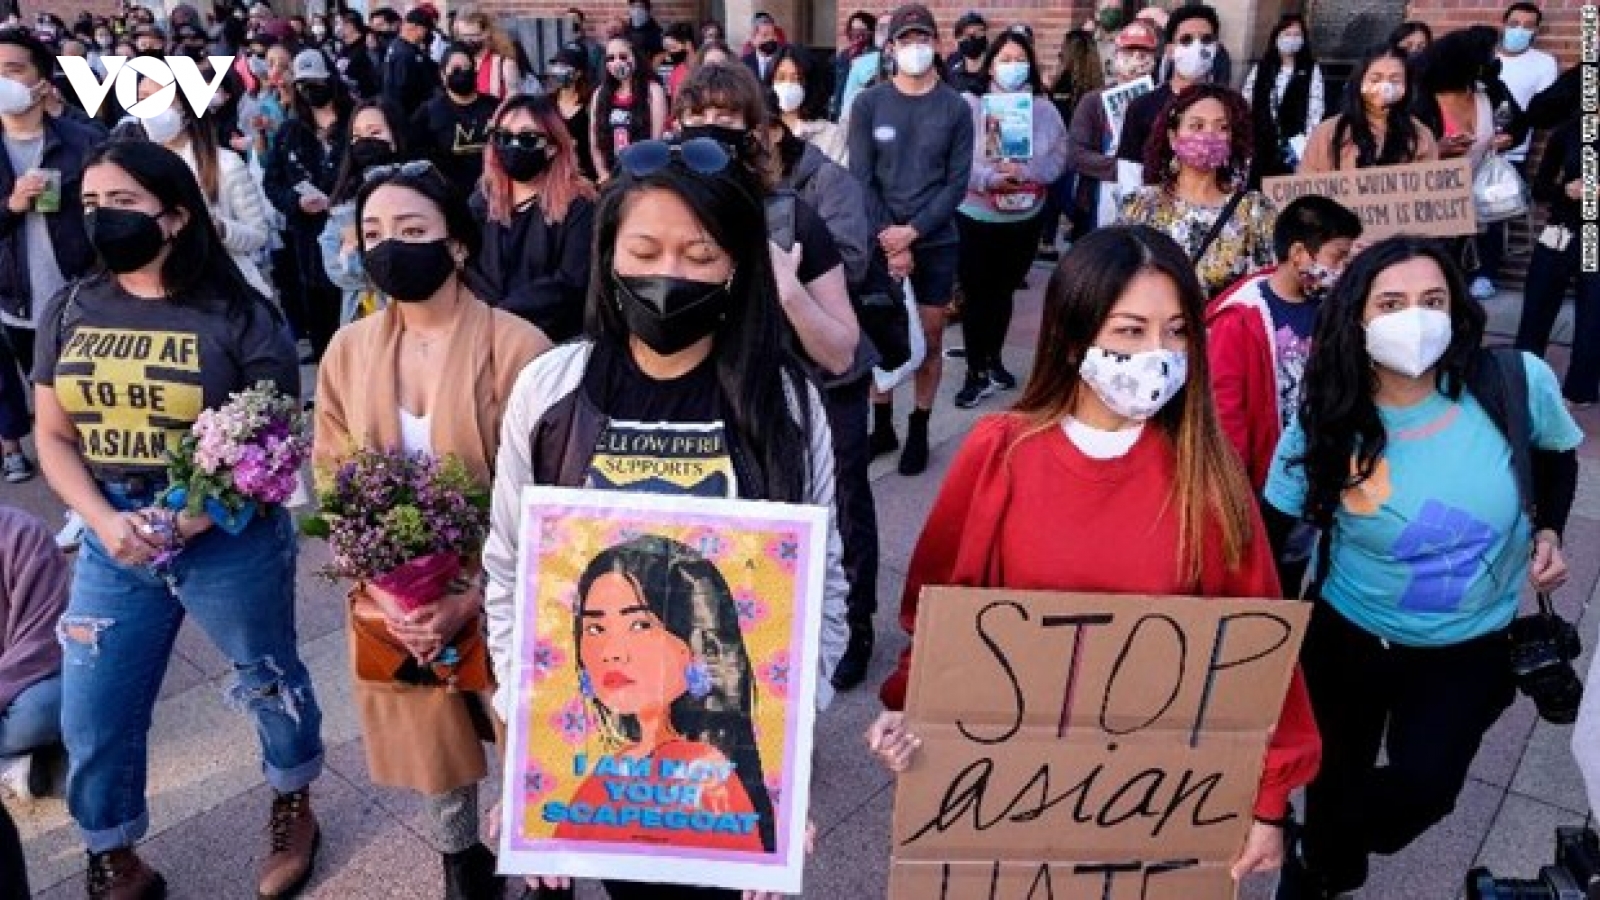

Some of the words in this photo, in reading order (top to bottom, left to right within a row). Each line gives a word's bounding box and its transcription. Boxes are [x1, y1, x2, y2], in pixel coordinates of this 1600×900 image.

[1354, 203, 1390, 226] ISM
[1397, 201, 1411, 225] IS
[63, 333, 152, 360] PROUD
[159, 336, 195, 365] AF
[77, 380, 117, 408] TO
[127, 384, 166, 412] BE
[88, 429, 166, 458] ASIAN
[671, 435, 724, 454] PERI
[605, 458, 703, 477] SUPPORTS
[955, 600, 1292, 748] STOP
[573, 752, 588, 777] I
[593, 755, 651, 778] AM
[659, 758, 736, 782] NOT
[604, 780, 701, 807] YOUR
[542, 800, 760, 834] SCAPEGOAT
